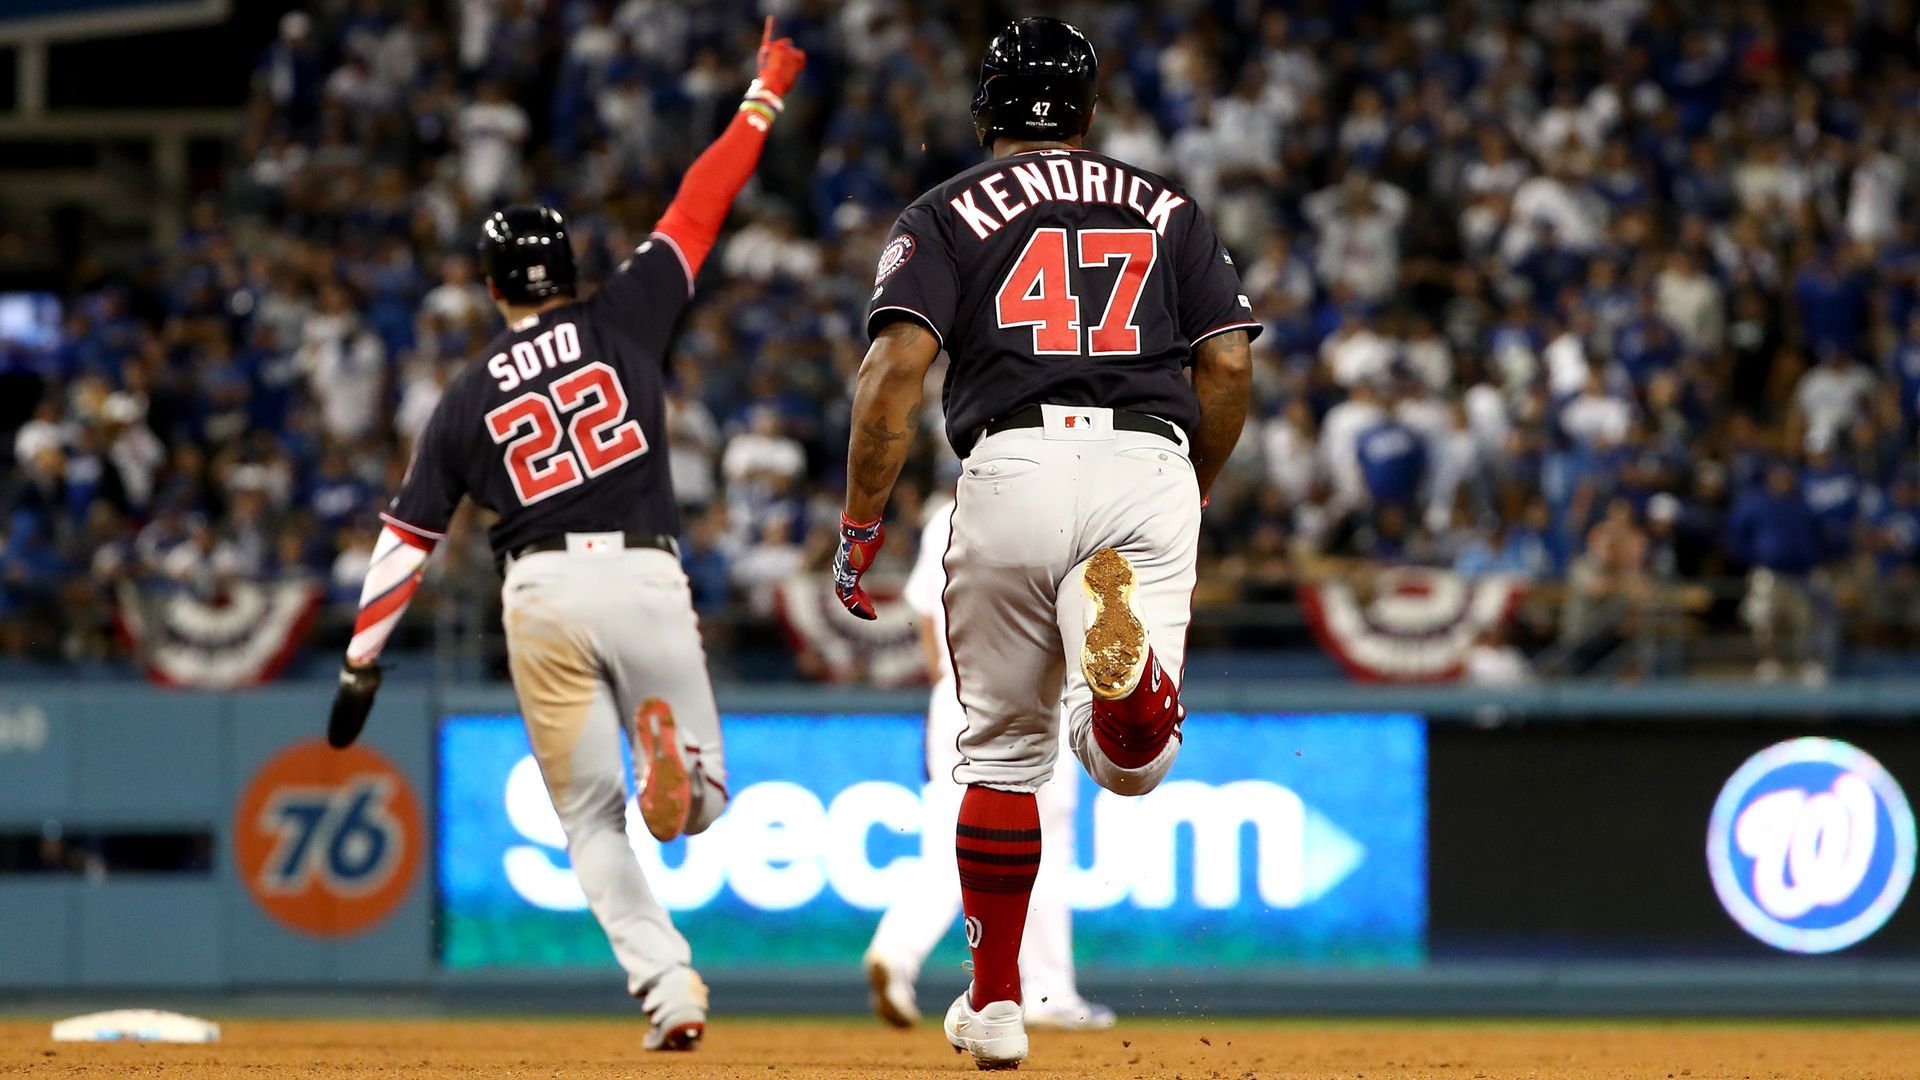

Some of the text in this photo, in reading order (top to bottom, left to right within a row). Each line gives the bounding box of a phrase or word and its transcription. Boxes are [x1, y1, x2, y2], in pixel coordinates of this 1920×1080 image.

[1032, 101, 1051, 116] 47
[950, 159, 1188, 240] KENDRICK
[995, 228, 1158, 356] 47
[487, 322, 581, 392] SOTO
[484, 361, 649, 507] 22
[262, 776, 402, 894] 76
[1735, 770, 1878, 920] W
